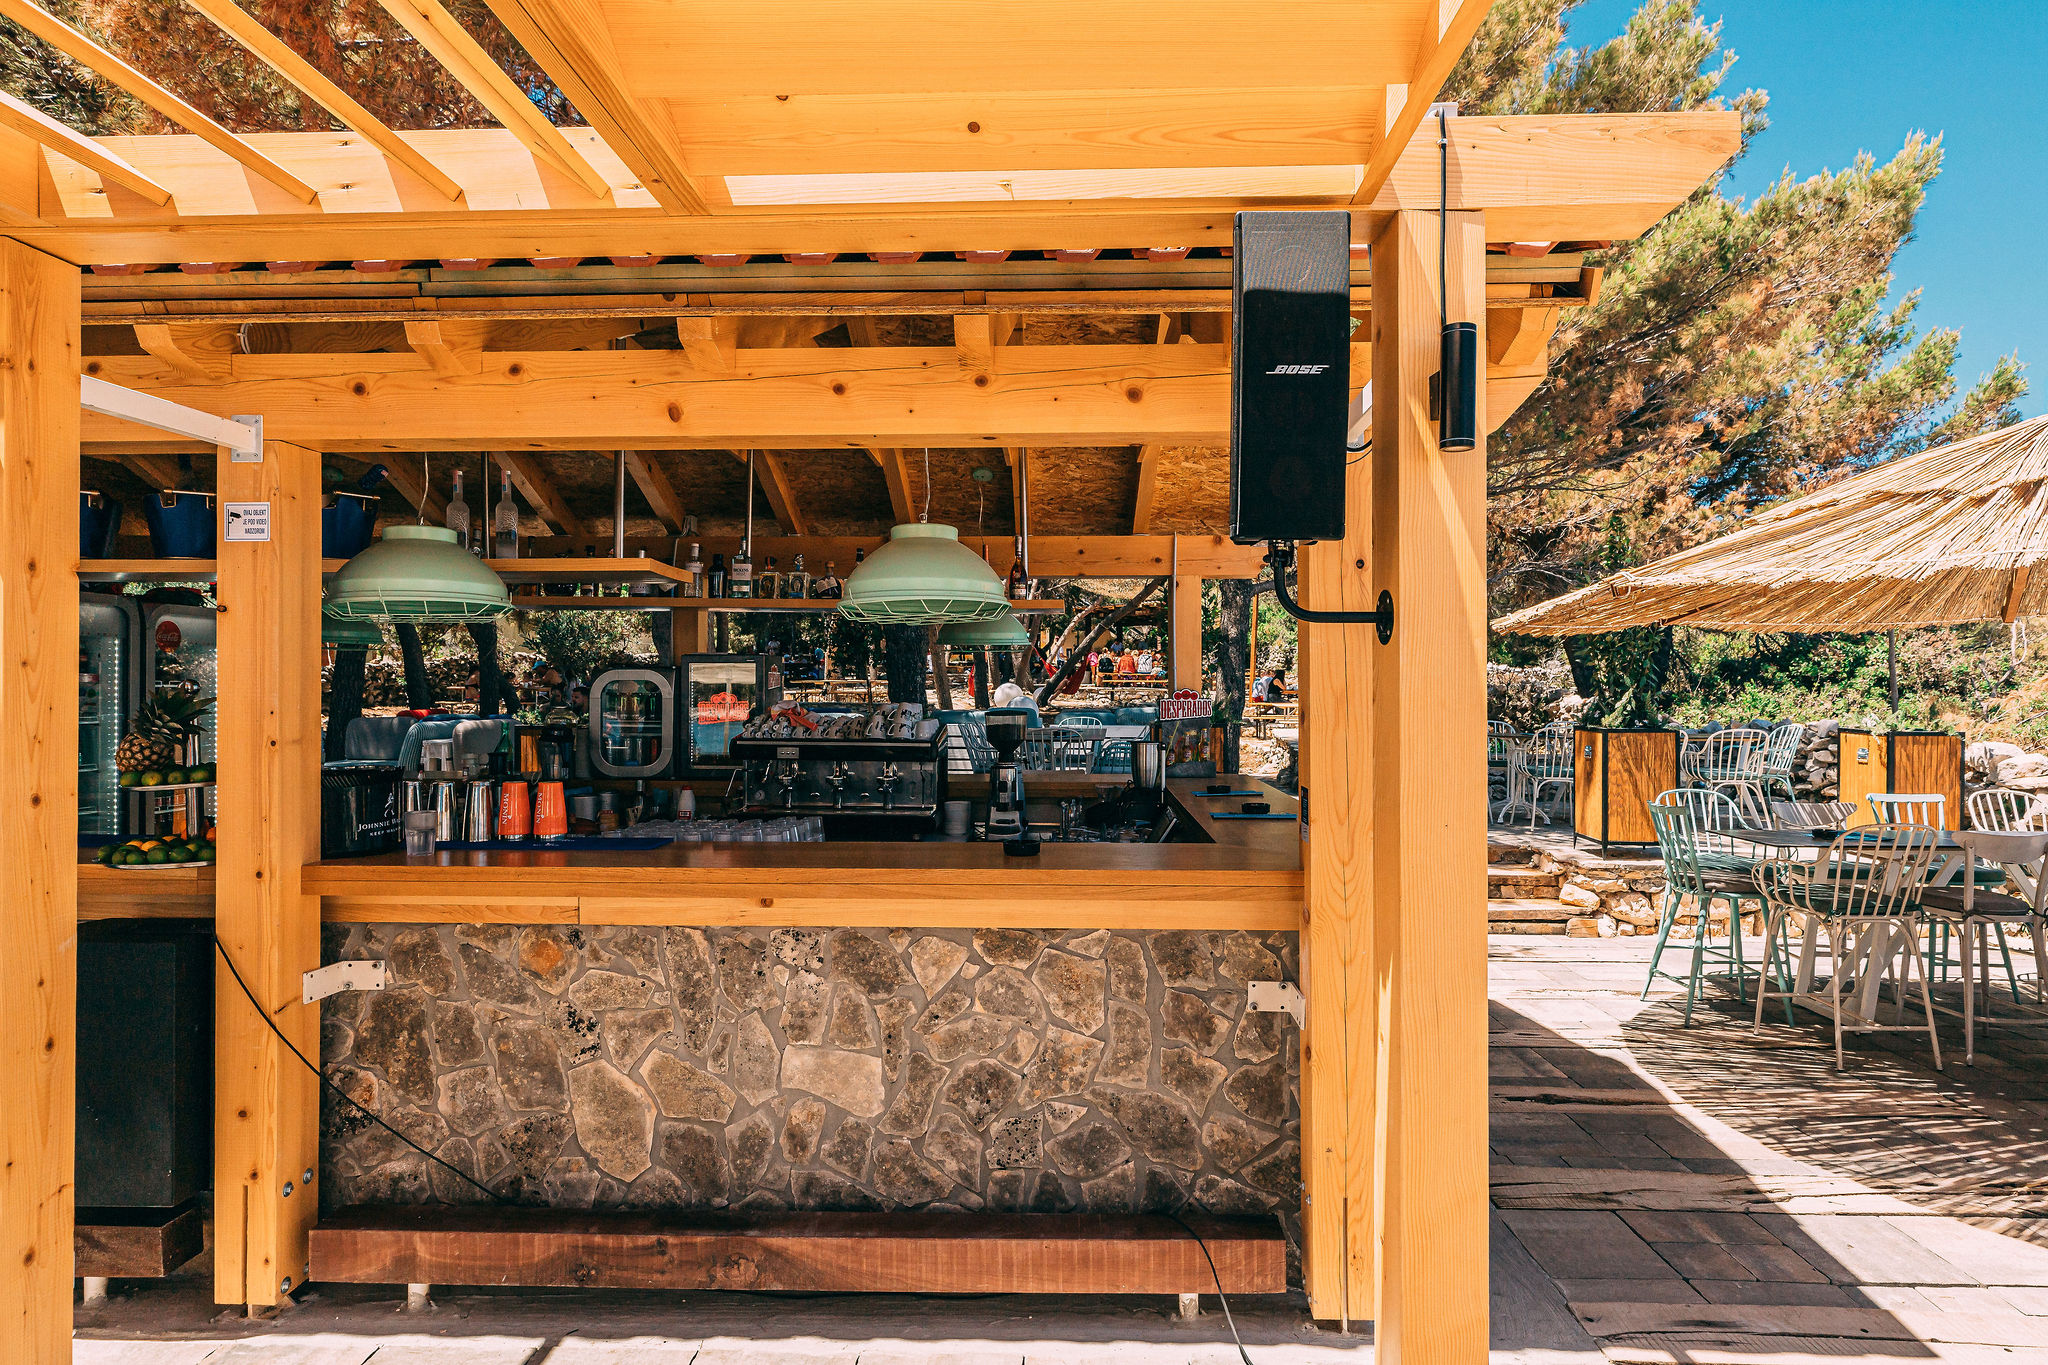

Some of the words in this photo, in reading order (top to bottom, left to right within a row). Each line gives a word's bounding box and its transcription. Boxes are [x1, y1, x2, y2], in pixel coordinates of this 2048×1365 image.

[1265, 364, 1330, 375] BOSE
[1160, 700, 1212, 719] DESPERADOS
[502, 793, 510, 825] MONIN
[358, 820, 390, 832] JOHNNIE
